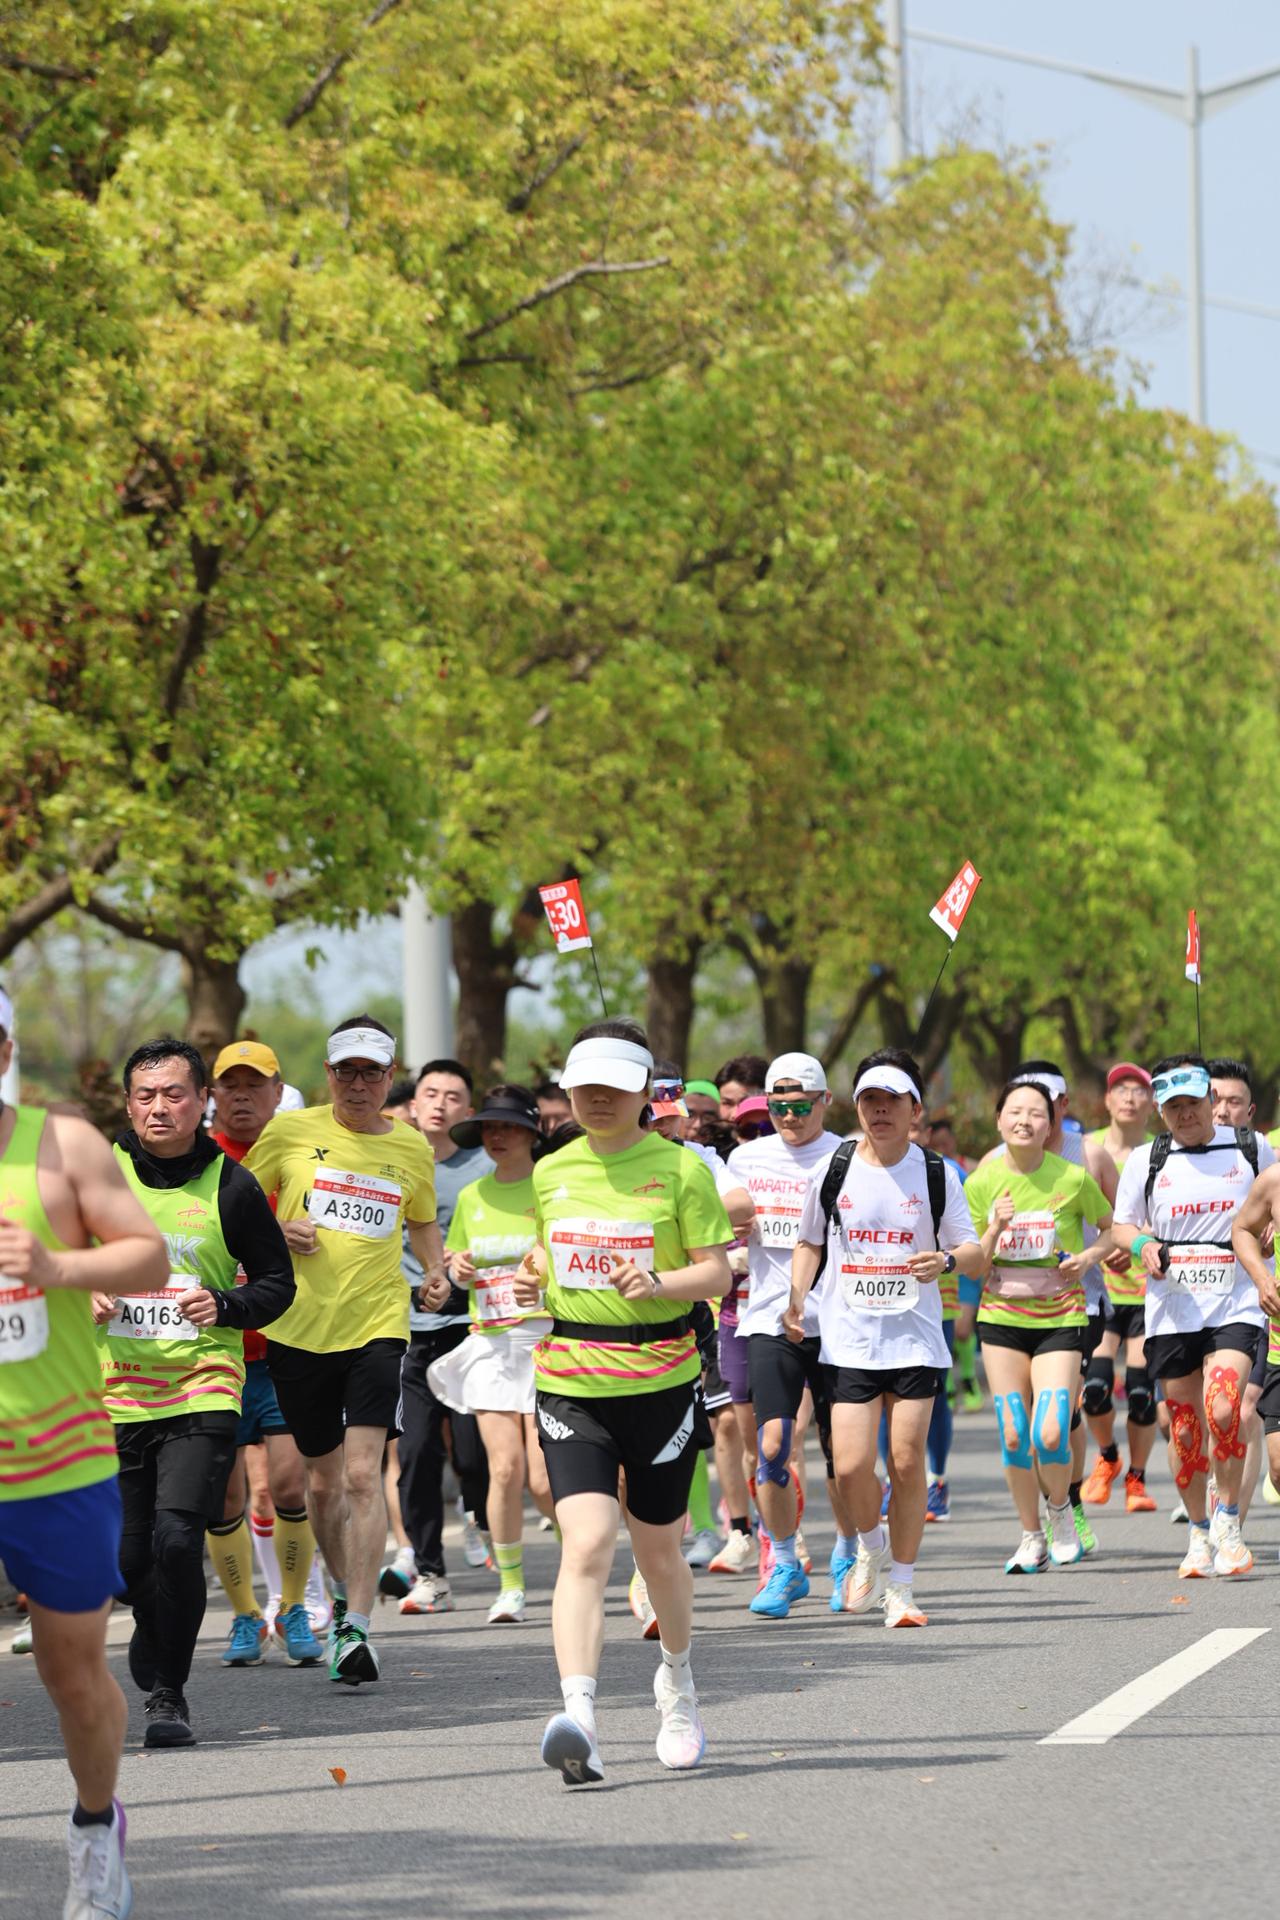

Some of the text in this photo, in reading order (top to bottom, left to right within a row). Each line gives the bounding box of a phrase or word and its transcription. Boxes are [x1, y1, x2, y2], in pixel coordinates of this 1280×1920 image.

[324, 1199, 385, 1226] A3300
[1171, 1200, 1234, 1217] PACER
[848, 1229, 914, 1245] PACER
[1177, 1269, 1226, 1284] A3557
[854, 1280, 907, 1297] A0072
[120, 1305, 184, 1326] A0163
